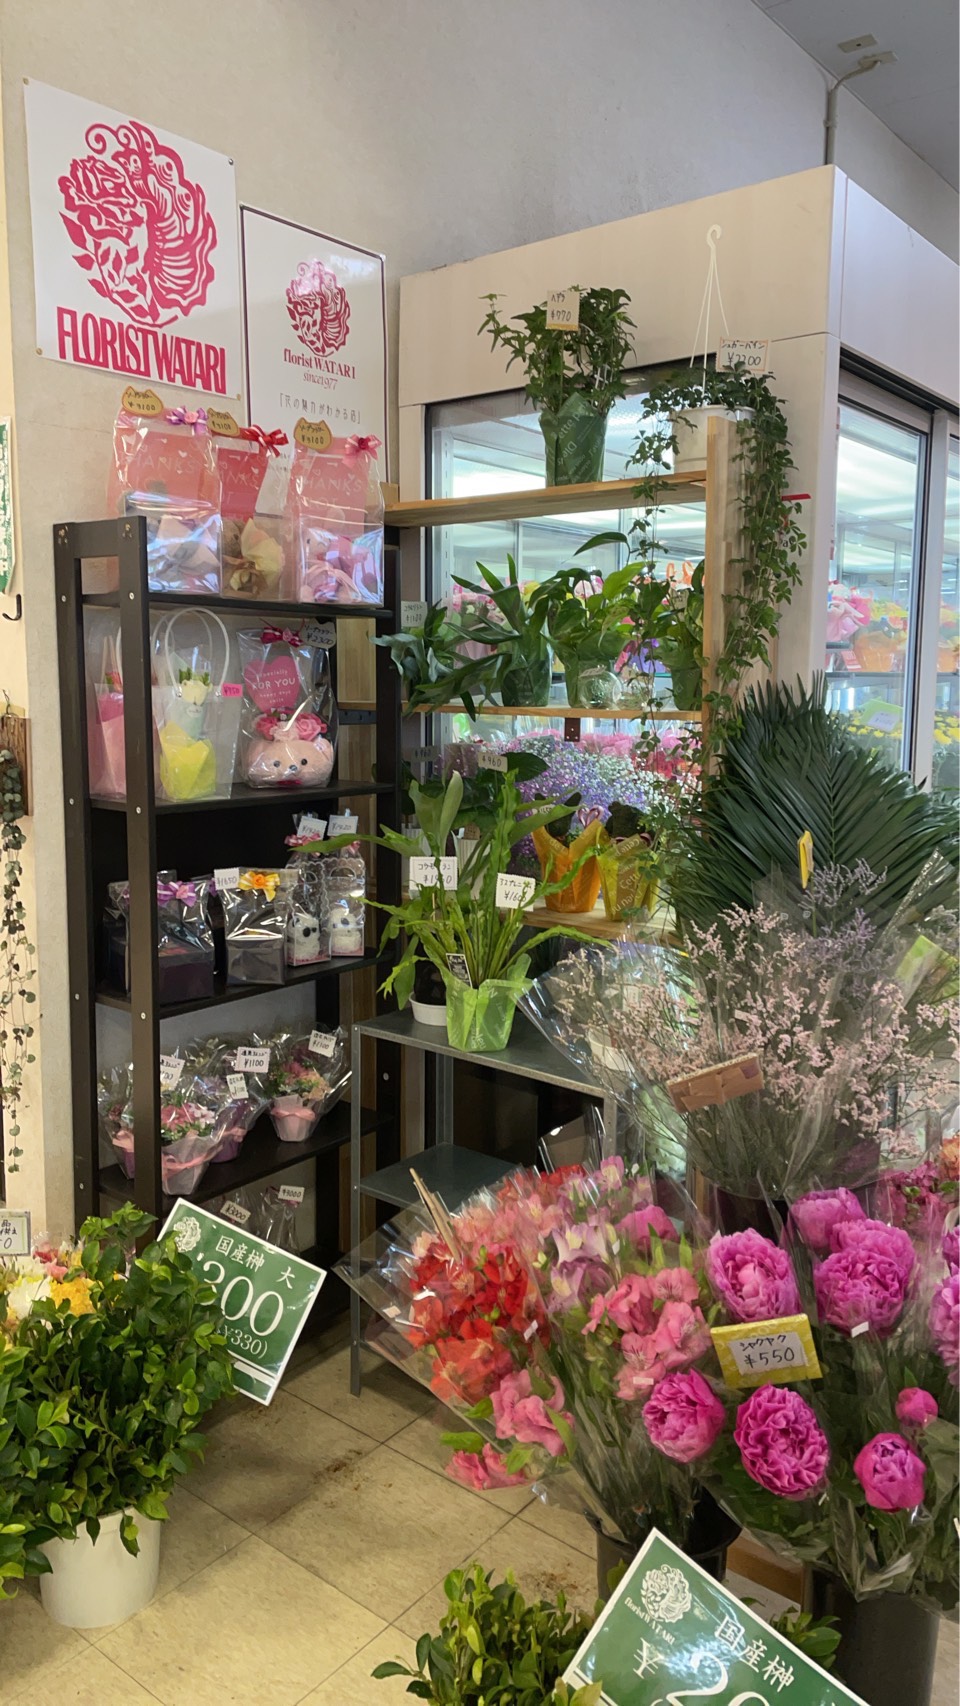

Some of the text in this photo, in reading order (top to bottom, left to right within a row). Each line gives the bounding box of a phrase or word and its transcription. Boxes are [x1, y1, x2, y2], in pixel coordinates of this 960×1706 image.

[550, 309, 571, 322] ¥770
[284, 348, 356, 379] florist WATARI
[728, 352, 761, 366] ¥2200
[274, 677, 296, 688] YOU
[482, 758, 502, 768] ¥960
[418, 862, 451, 871] コウモラン
[244, 1057, 264, 1069] ¥1100
[215, 1235, 296, 1290] 国産榊 大
[739, 1334, 787, 1351] シャクヤク
[744, 1346, 795, 1369] ¥550
[641, 1611, 676, 1645] WATARI
[714, 1615, 795, 1693] 国産榊
